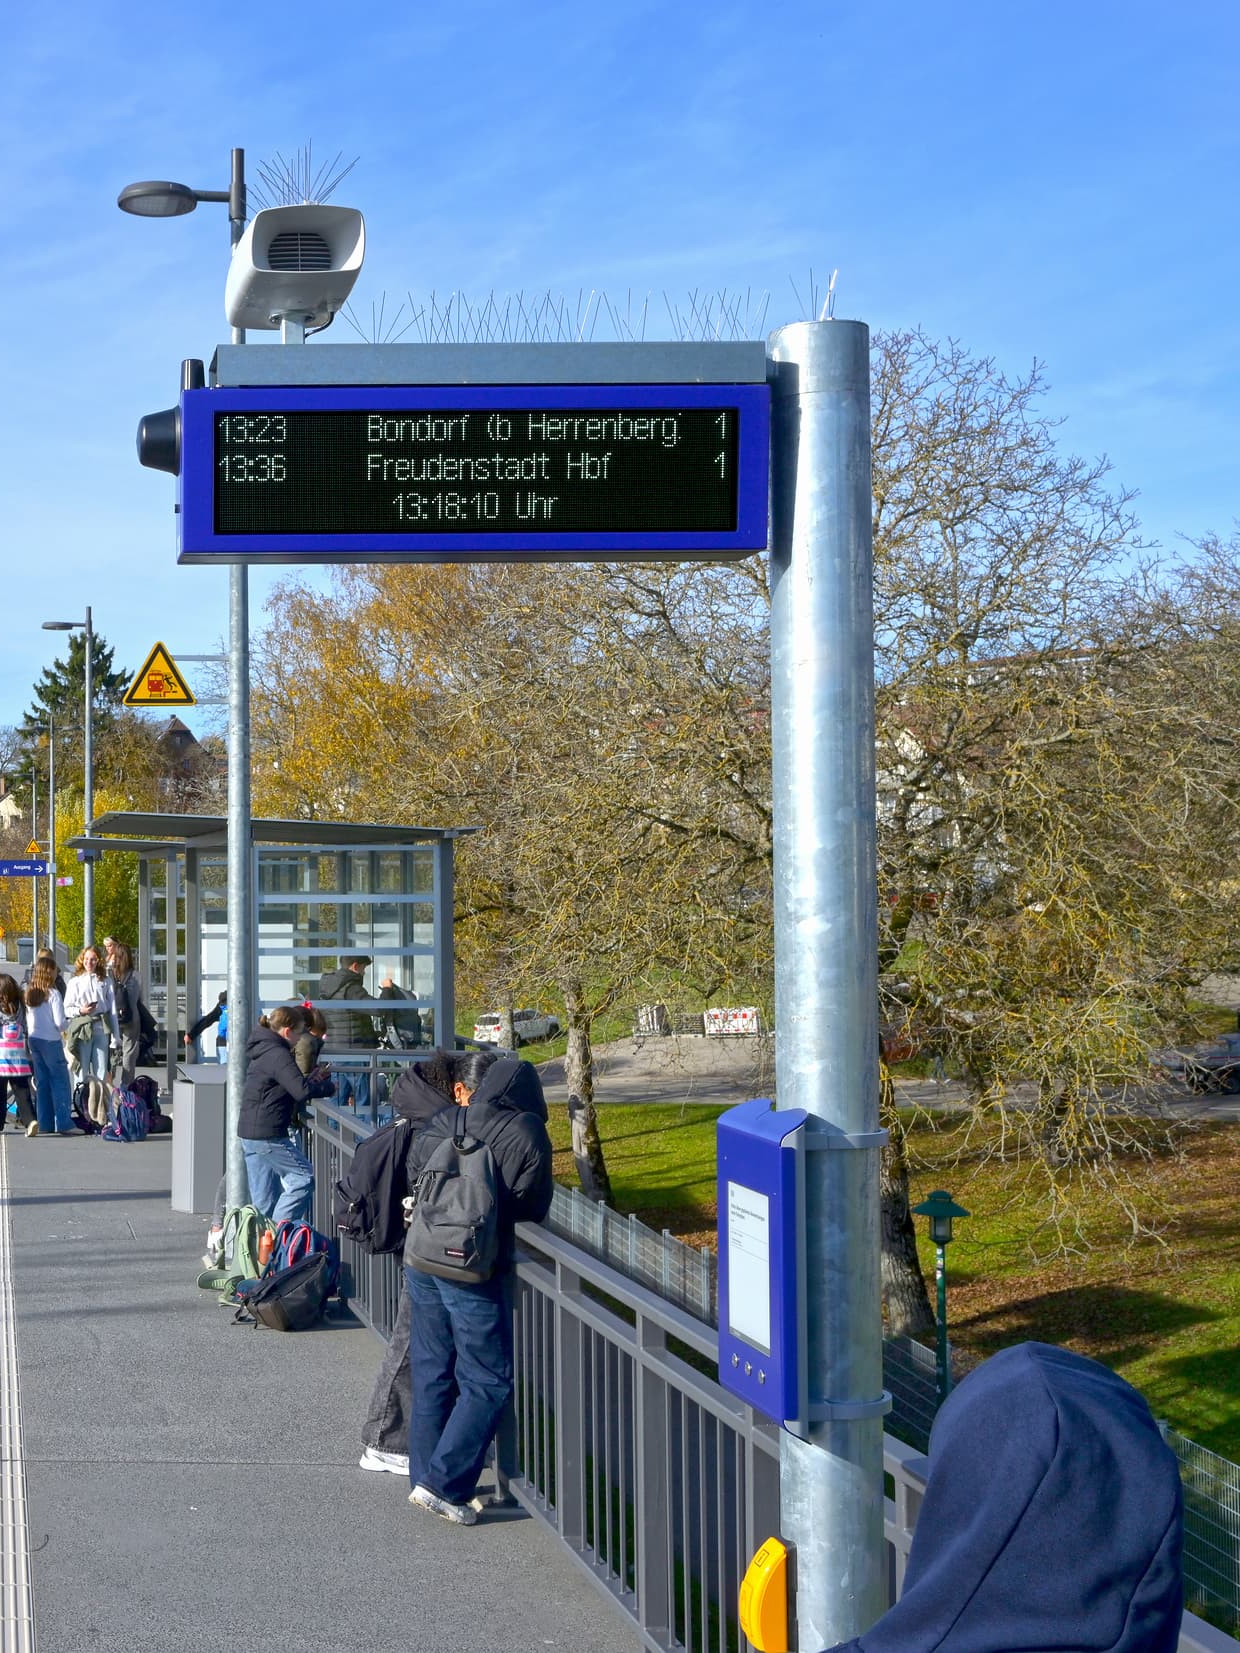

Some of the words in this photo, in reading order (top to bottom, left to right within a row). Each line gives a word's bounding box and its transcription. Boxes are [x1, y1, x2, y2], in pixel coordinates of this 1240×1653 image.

[218, 415, 287, 443] 13:23
[366, 414, 470, 442] Bondorf
[487, 413, 511, 441] (b
[528, 413, 682, 447] Herrenberg
[715, 412, 726, 440] 1
[218, 454, 287, 482] 13:36
[366, 452, 550, 481] Freudenstadt
[567, 452, 612, 480] Hbf
[714, 451, 725, 479] 1
[392, 492, 499, 520] 13:18:10
[516, 491, 559, 519] Uhr
